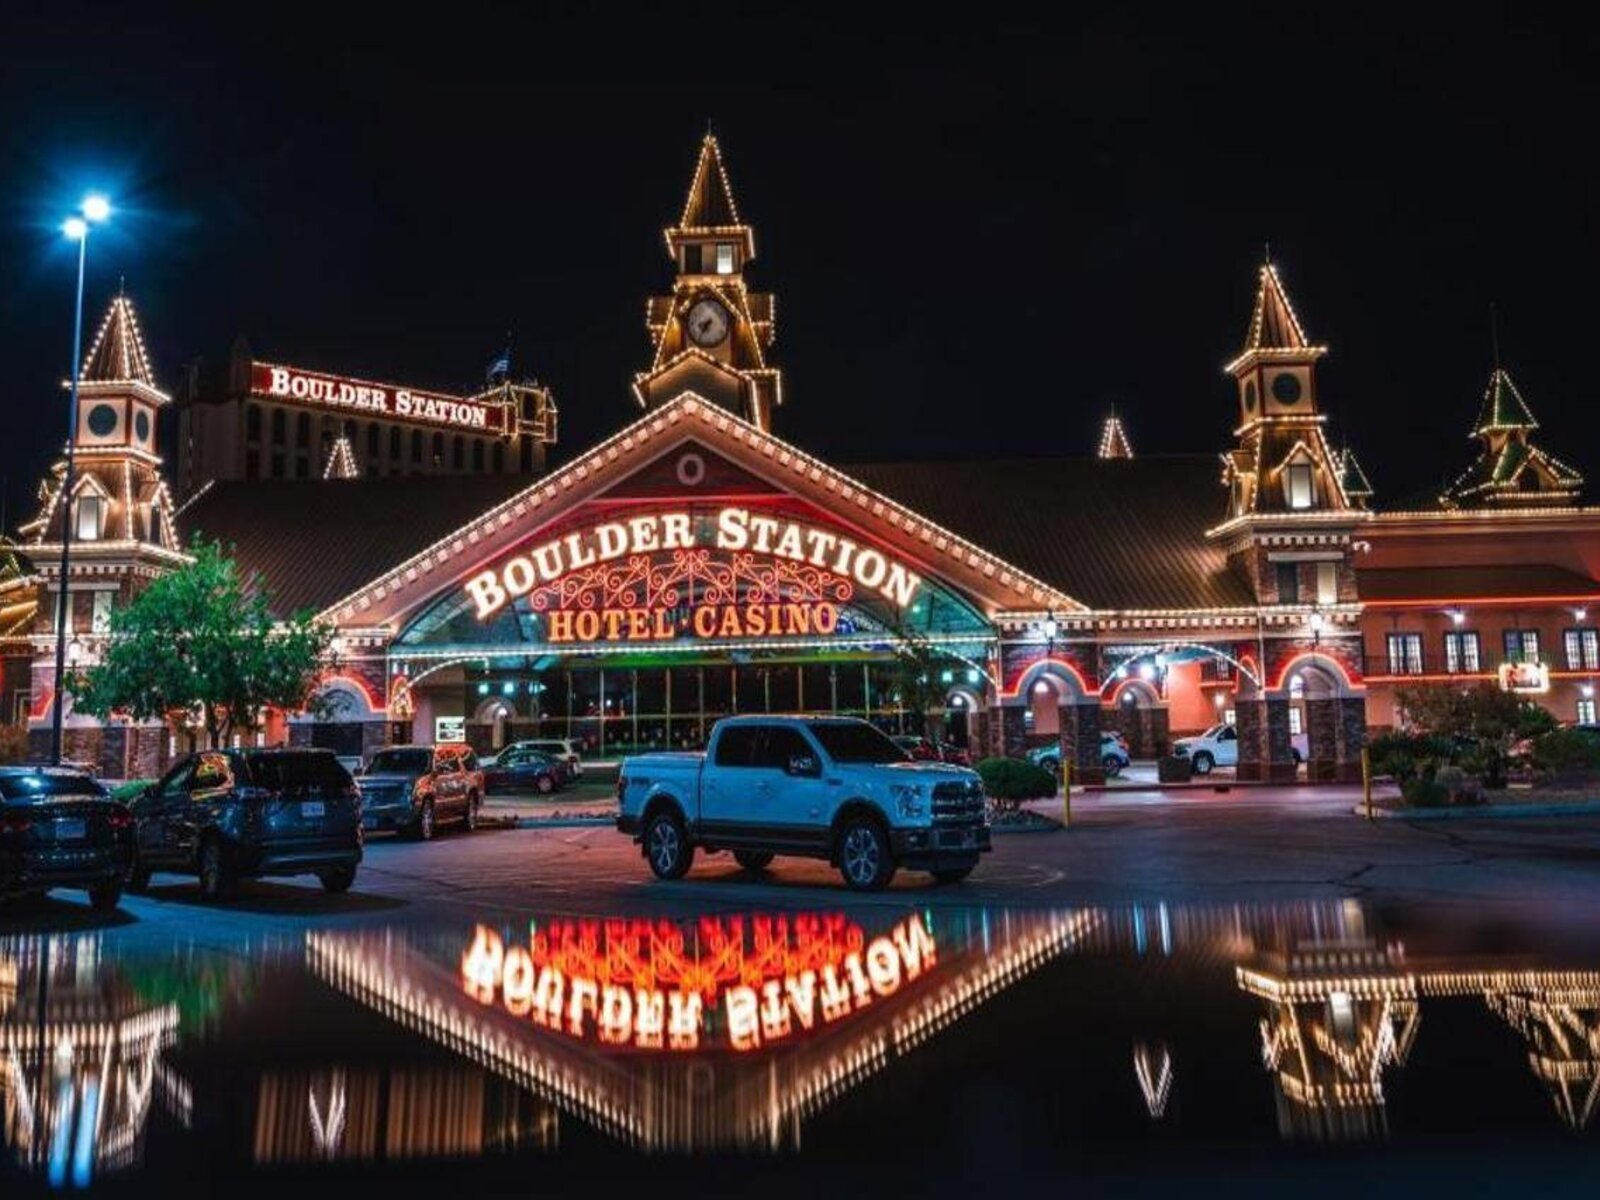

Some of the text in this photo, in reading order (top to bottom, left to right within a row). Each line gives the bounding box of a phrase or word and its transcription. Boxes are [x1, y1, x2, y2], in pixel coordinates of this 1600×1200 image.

[270, 367, 487, 427] BOULDER STATION
[464, 508, 921, 619] BOULDER STATION
[547, 601, 838, 643] HOTEL CASINO
